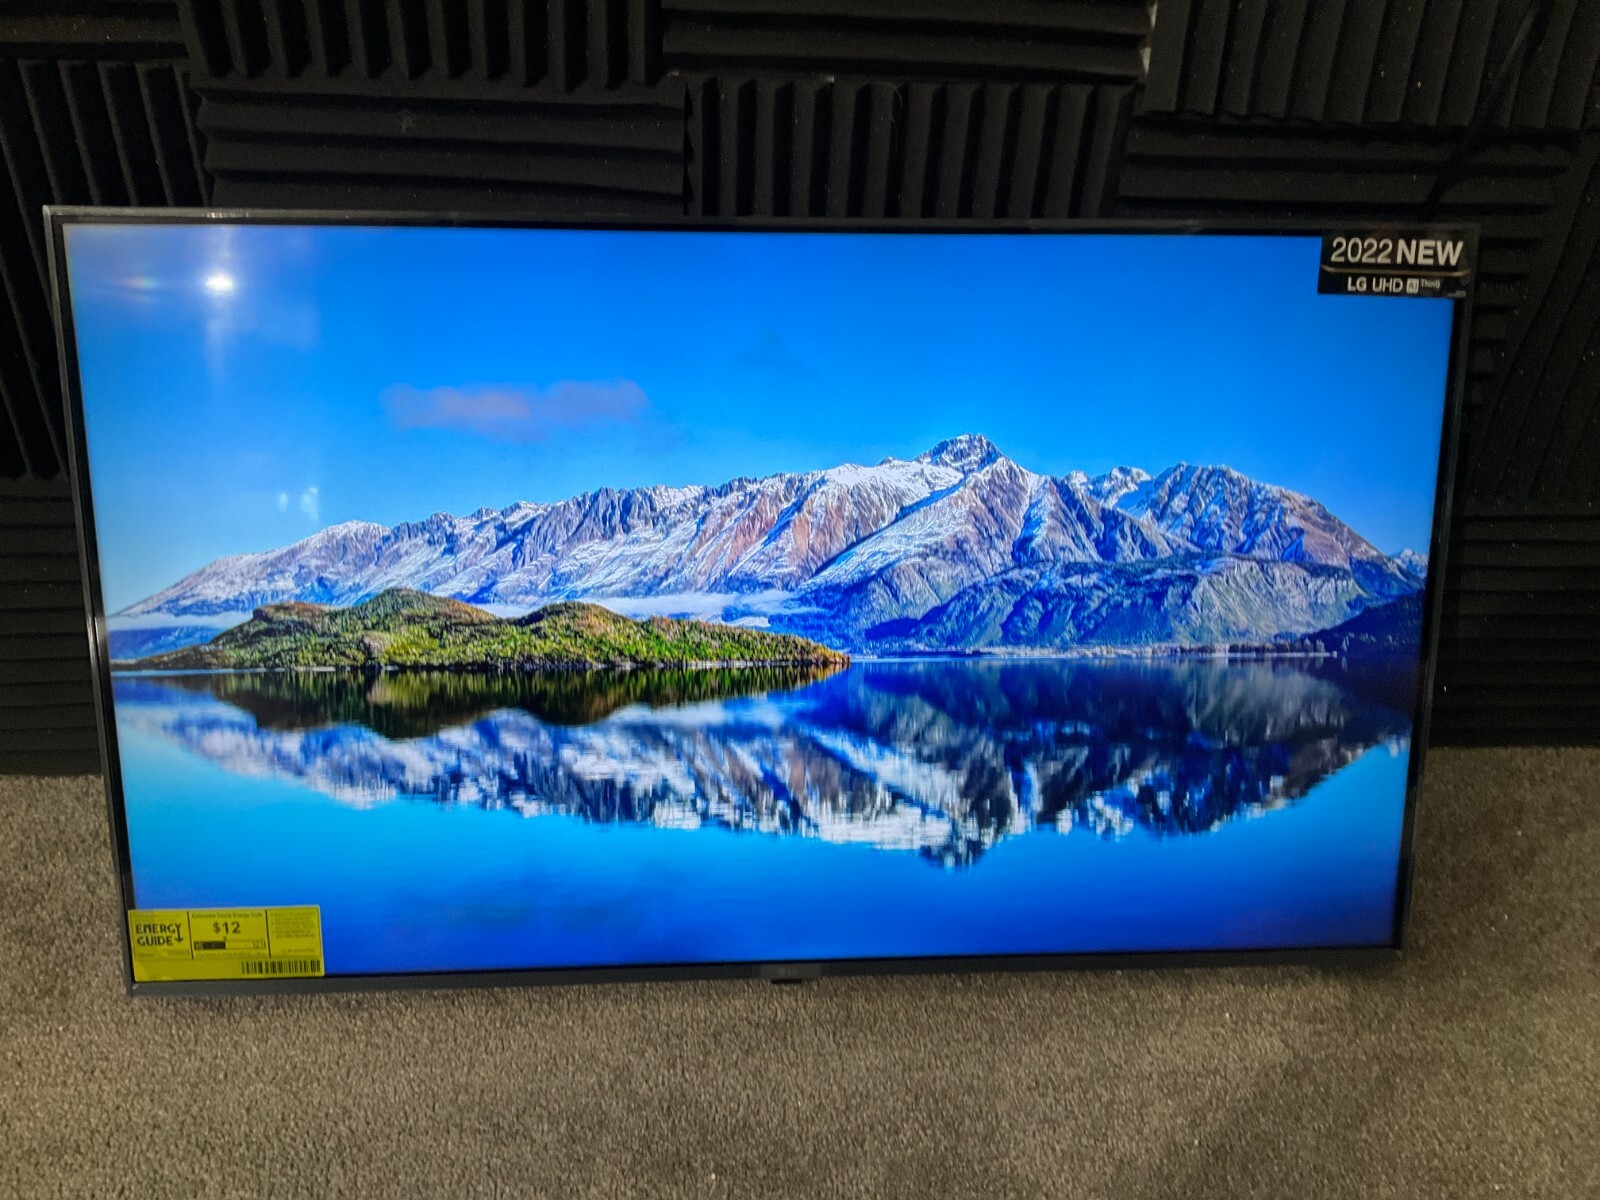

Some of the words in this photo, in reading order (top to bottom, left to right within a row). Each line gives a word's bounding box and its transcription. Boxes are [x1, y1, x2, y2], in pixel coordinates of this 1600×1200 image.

[1331, 236, 1393, 264] 2022
[1396, 238, 1464, 266] NEW
[1347, 276, 1367, 292] LG
[1372, 276, 1403, 293] UHD
[135, 923, 182, 936] ENERGY
[213, 921, 241, 935] $12
[137, 935, 173, 947] GUIDE
